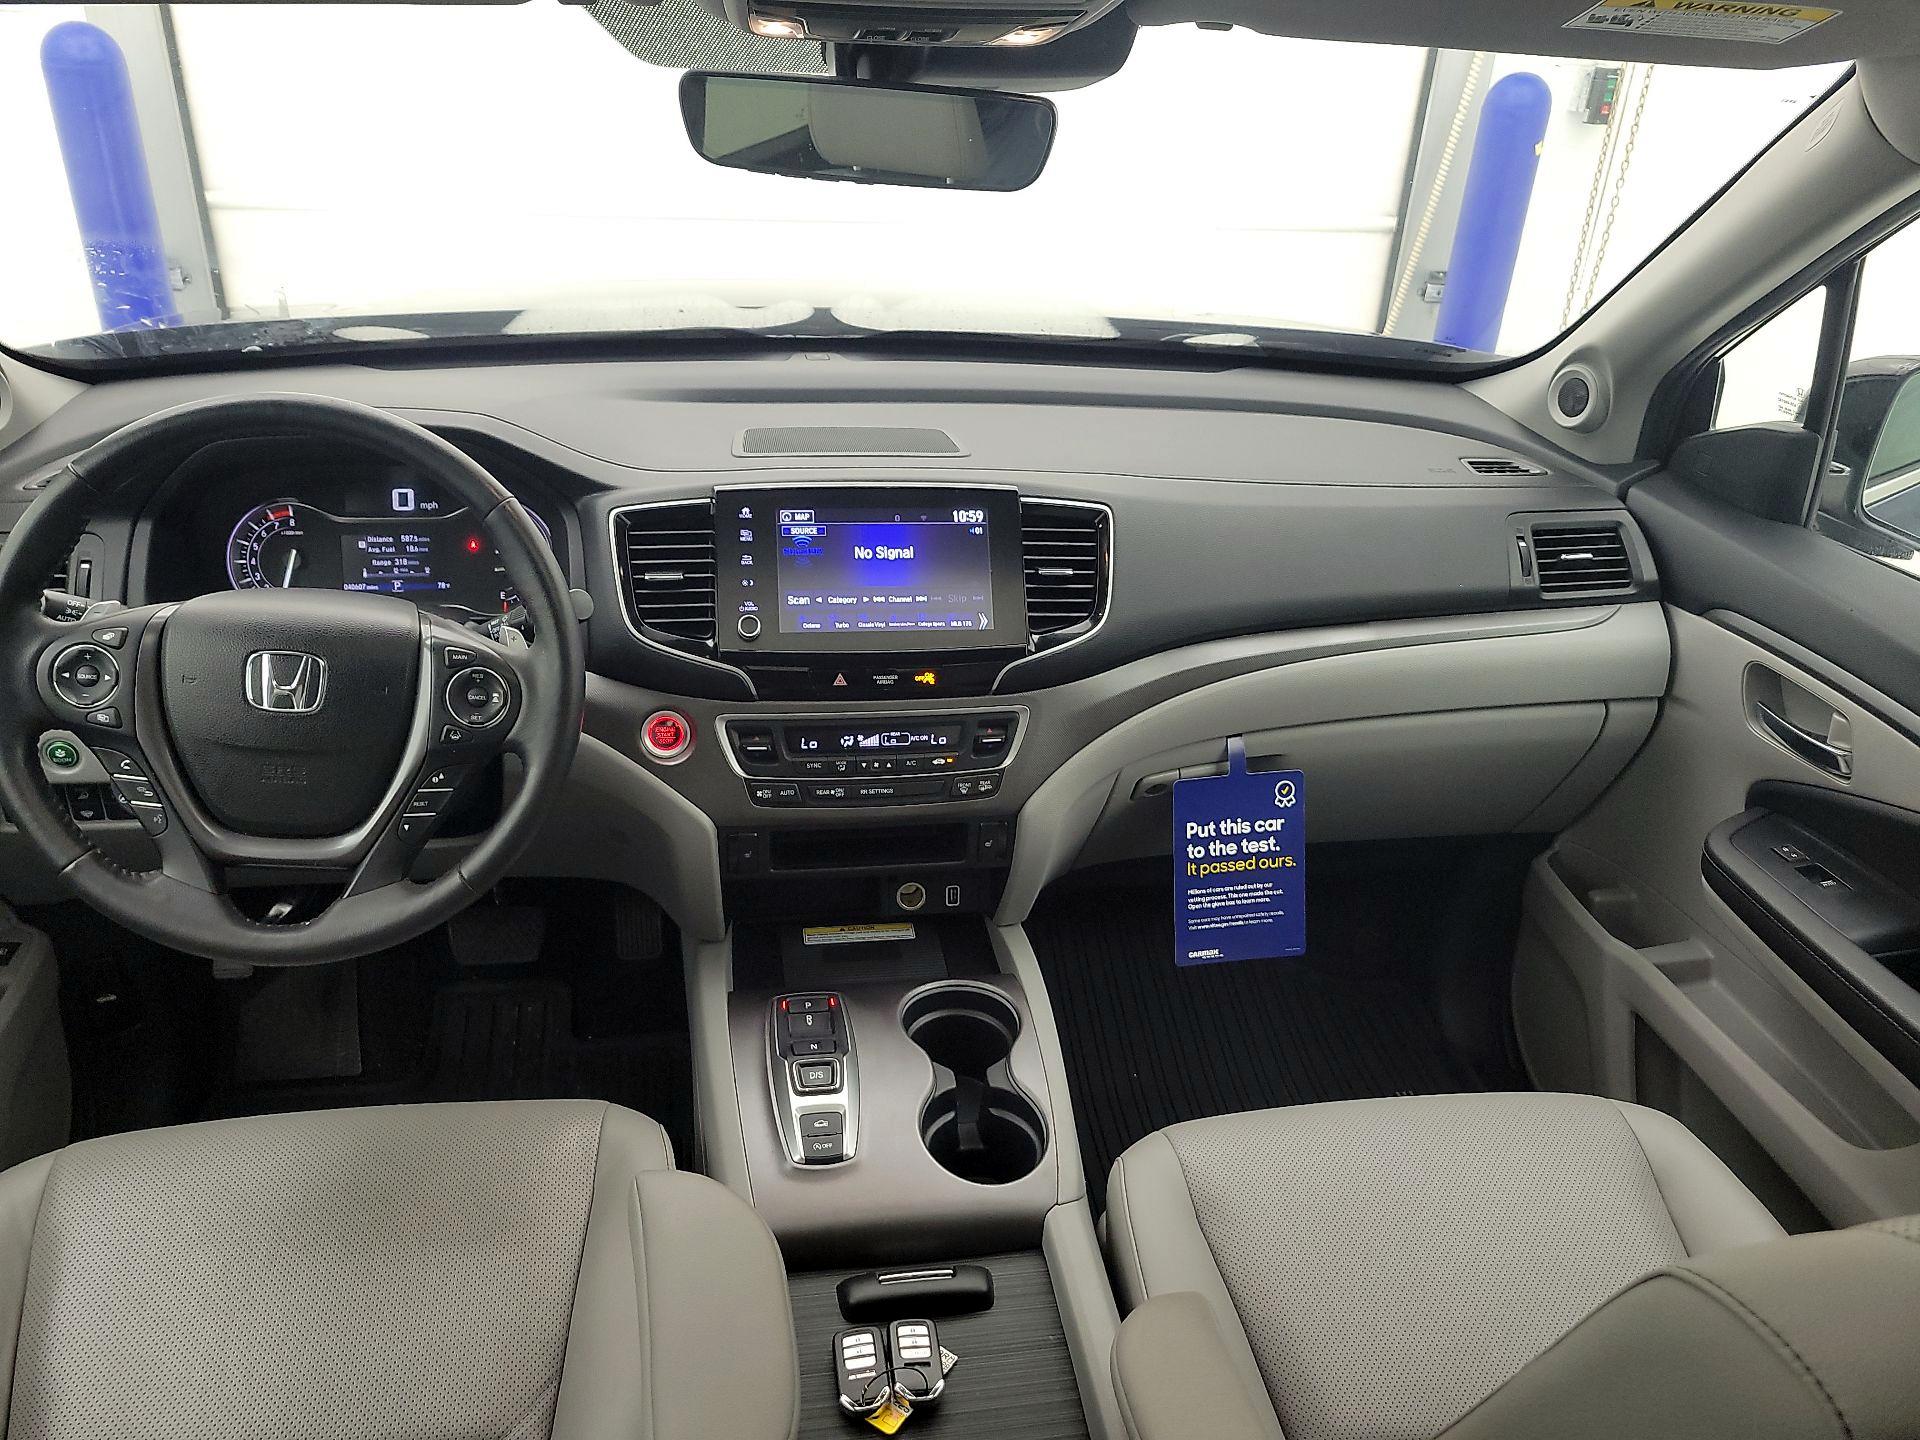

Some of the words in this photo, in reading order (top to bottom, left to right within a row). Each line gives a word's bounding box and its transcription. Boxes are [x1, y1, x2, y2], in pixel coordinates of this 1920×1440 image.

[1672, 1, 1802, 17] WARNING
[392, 488, 415, 511] 0
[420, 501, 439, 510] mph
[794, 513, 811, 521] MAP
[953, 509, 984, 523] 10:59
[273, 522, 279, 530] 7
[289, 518, 296, 527] 8
[261, 530, 267, 538] 6
[790, 527, 818, 535] SOURCE
[252, 542, 259, 551] 5
[854, 546, 873, 560] No
[875, 545, 914, 561] Signal
[250, 557, 256, 565] 4
[254, 572, 261, 581] 3
[500, 591, 506, 600] E
[787, 595, 811, 605] Scan
[827, 596, 858, 604] Category
[888, 595, 913, 603] Channel
[948, 594, 967, 604] Skip
[67, 599, 81, 607] OFF
[801, 737, 818, 749] Lo
[931, 733, 947, 745] Lo
[1186, 821, 1217, 840] Put
[1219, 817, 1252, 836] this
[1254, 818, 1285, 833] car
[1186, 843, 1206, 860] to
[1208, 839, 1238, 857] the
[1240, 835, 1281, 854] test.
[1187, 862, 1197, 876] It
[1199, 855, 1256, 879] passed
[1258, 856, 1297, 869] ours.
[1187, 903, 1202, 911] Open
[1211, 900, 1226, 909] glove
[805, 1001, 812, 1009] P
[809, 1071, 824, 1080] D/S
